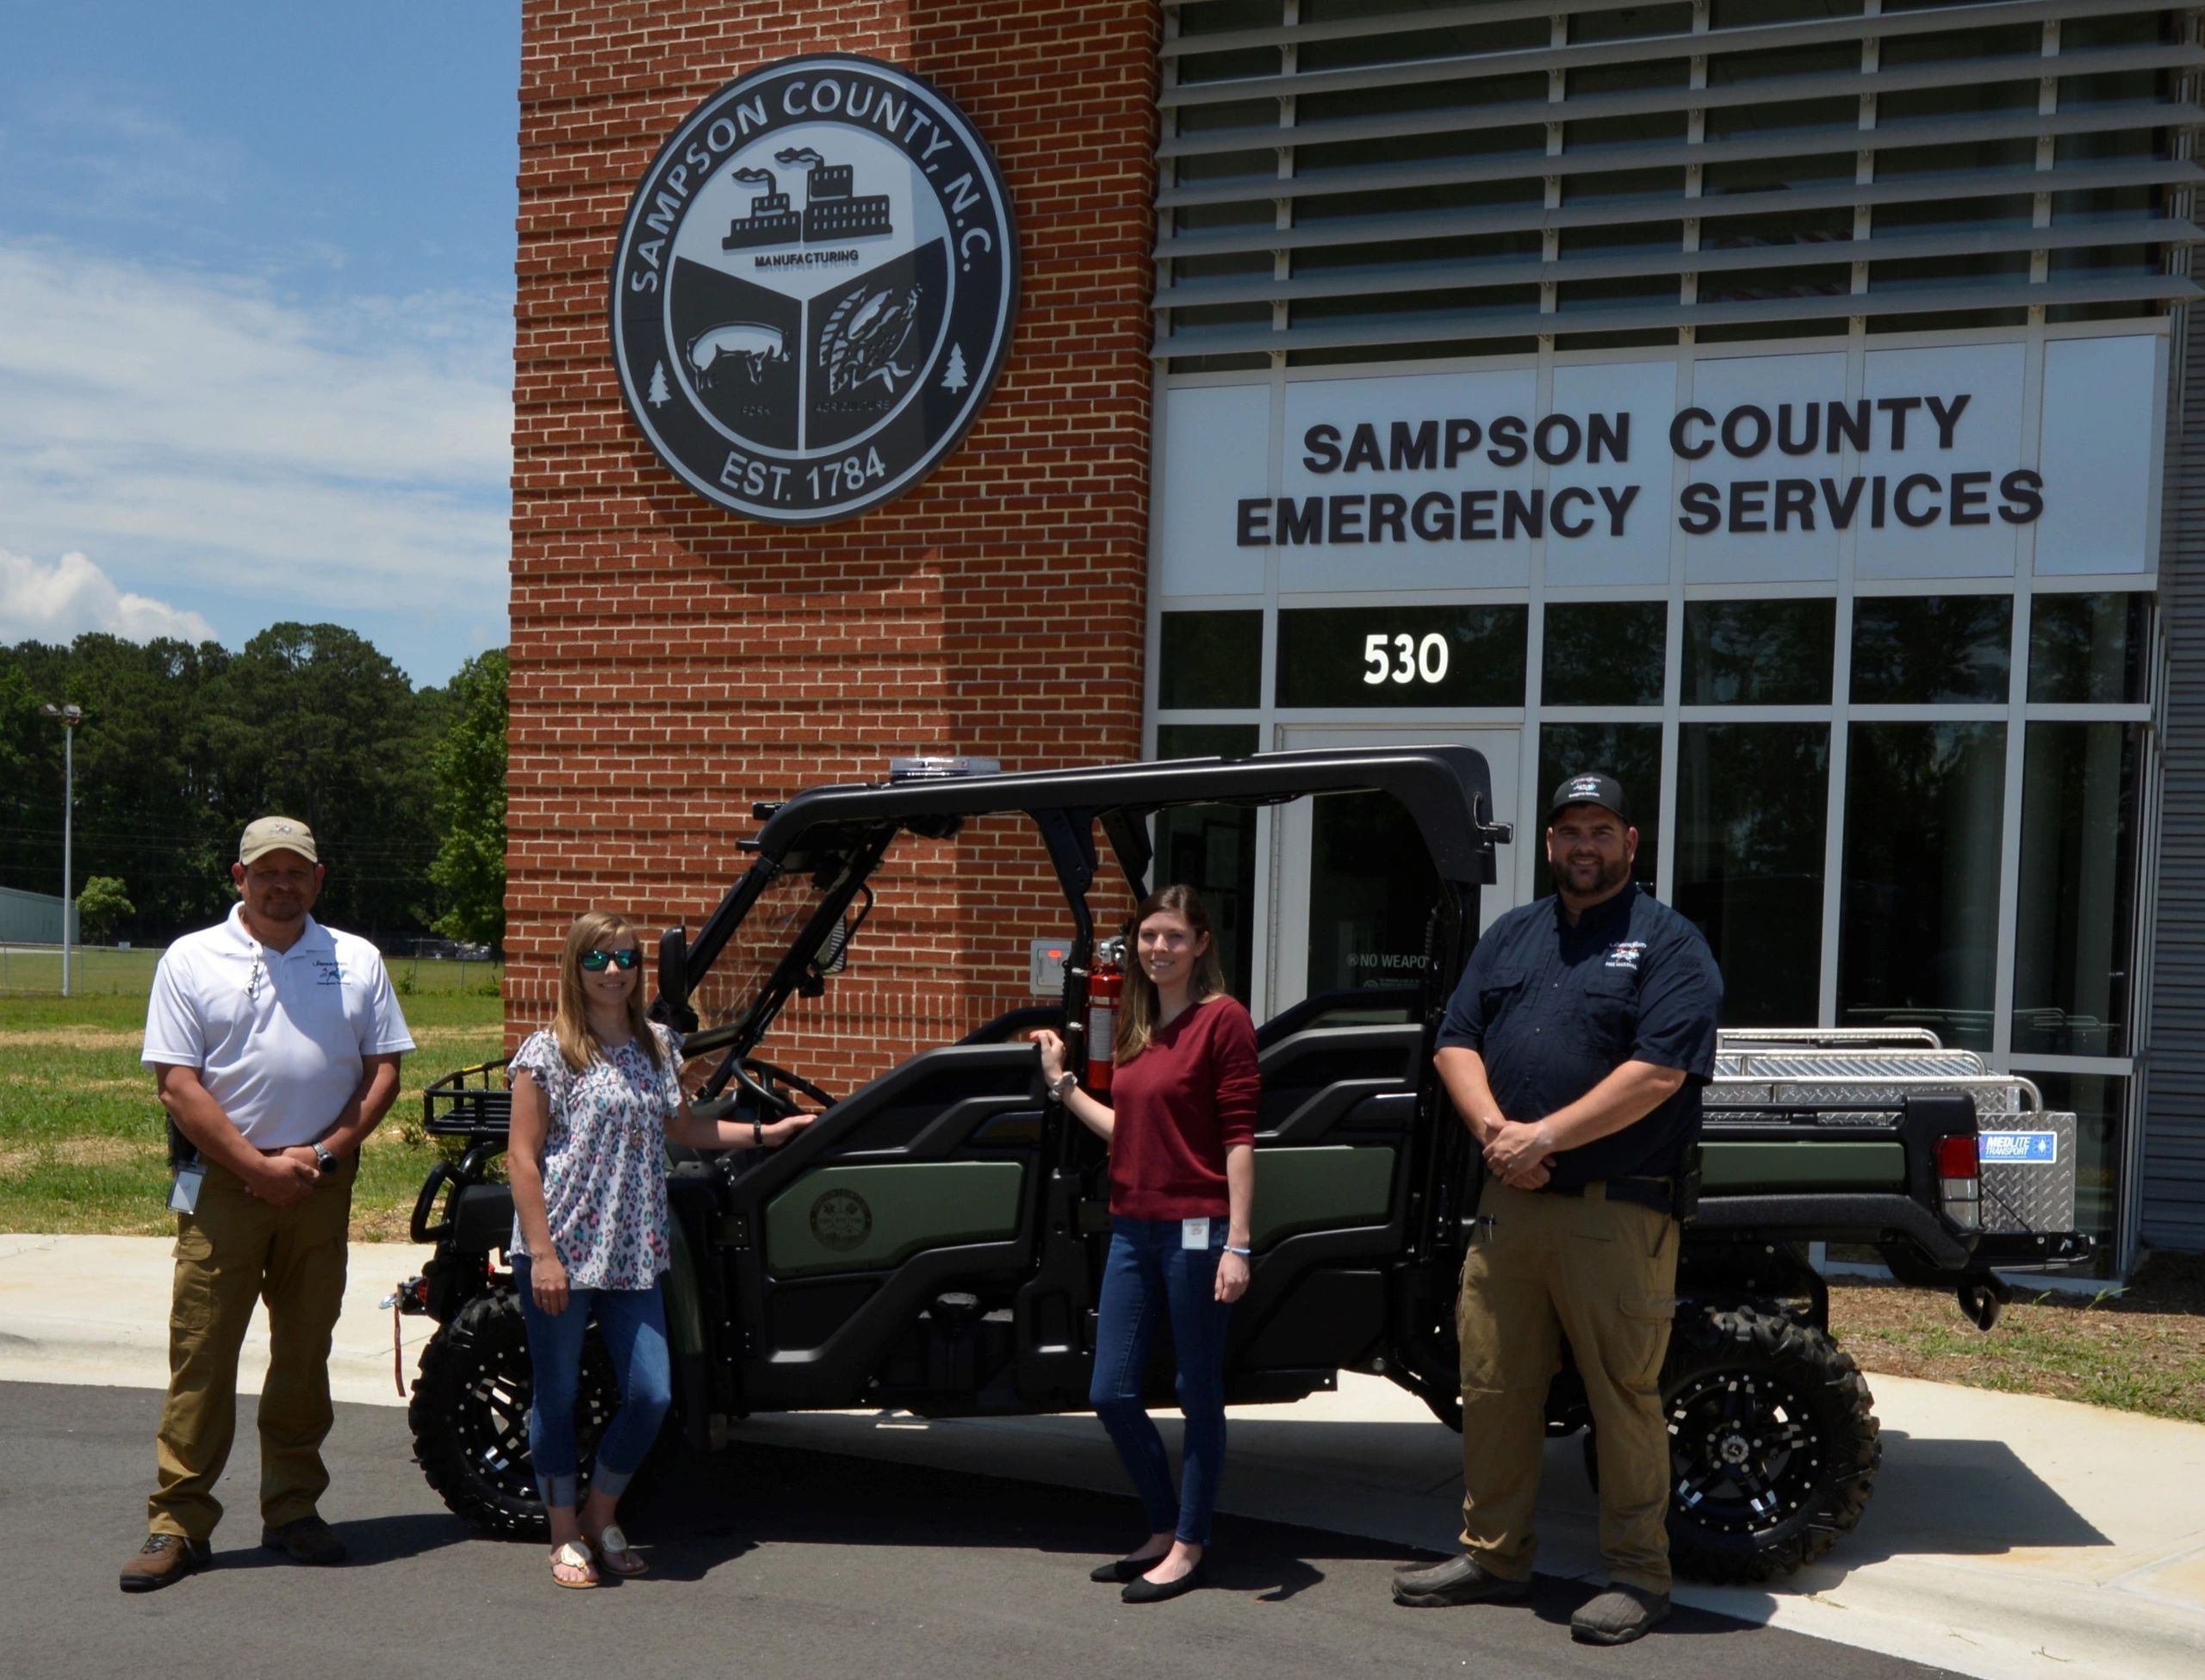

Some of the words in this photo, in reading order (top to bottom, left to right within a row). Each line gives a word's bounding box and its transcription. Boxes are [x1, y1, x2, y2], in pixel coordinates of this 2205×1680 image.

[630, 94, 768, 294] SAMPSON
[782, 79, 953, 173] COUNTY,
[943, 172, 991, 272] N.C.
[755, 250, 859, 267] MANUFACTURING
[1302, 412, 1630, 474] SAMPSON
[1669, 394, 1972, 462] COUNTY
[719, 450, 792, 501] EST.
[805, 446, 886, 500] 1784
[1236, 485, 1641, 548] EMERGENCY
[1678, 468, 2045, 536] SERVICES
[1363, 633, 1449, 685] 530
[1361, 953, 1378, 967] NO
[1381, 954, 1426, 969] WEAPO
[1984, 1146, 2028, 1156] TRANSPORT
[1986, 1136, 2031, 1147] MEDLITE
